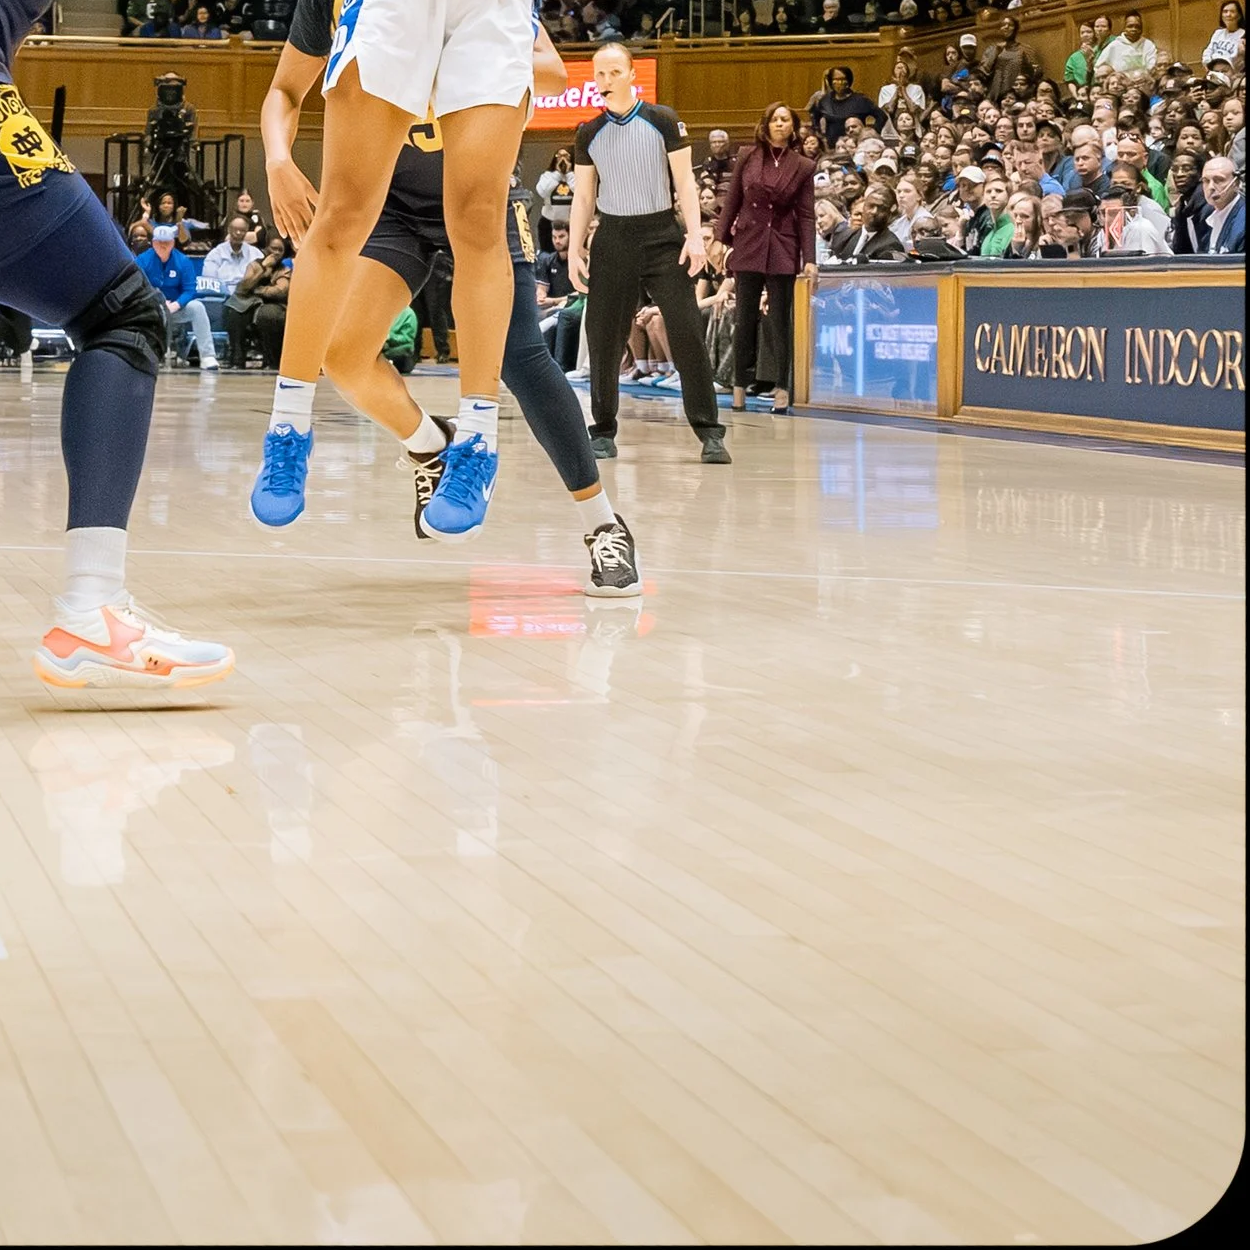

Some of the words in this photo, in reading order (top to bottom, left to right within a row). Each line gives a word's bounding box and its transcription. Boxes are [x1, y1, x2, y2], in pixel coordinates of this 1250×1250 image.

[533, 81, 637, 109] ateFa
[974, 322, 1107, 382] CAMERON
[1124, 326, 1246, 391] INDOOR
